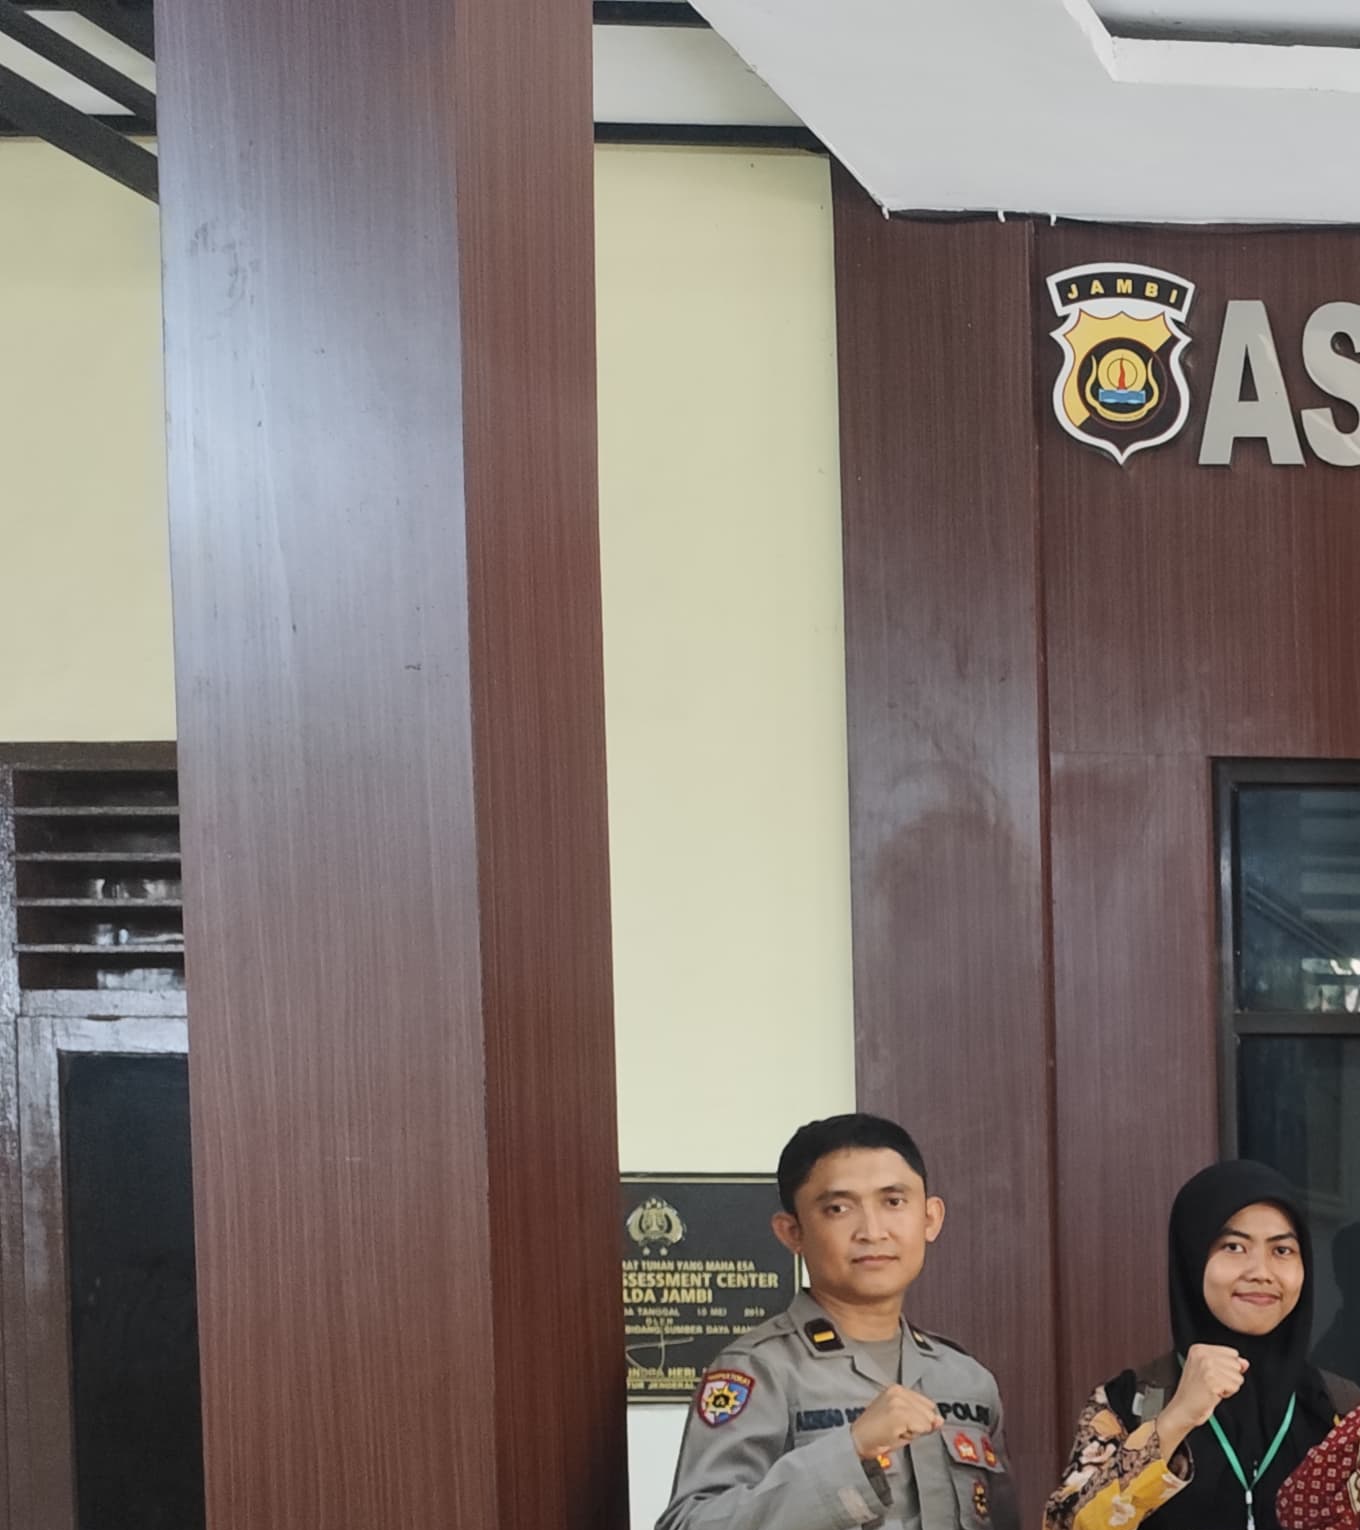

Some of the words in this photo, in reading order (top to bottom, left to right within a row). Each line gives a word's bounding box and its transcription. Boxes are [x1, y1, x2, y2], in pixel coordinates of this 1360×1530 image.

[1067, 278, 1178, 304] JAMBI
[642, 1260, 674, 1271] TUHAN
[676, 1260, 703, 1271] YANG
[705, 1260, 735, 1271] MAHA
[737, 1260, 755, 1271] ESA
[716, 1272, 778, 1289] CENTER
[623, 1288, 656, 1303] LDA
[660, 1288, 713, 1303] JAMBI
[637, 1307, 680, 1317] TANGGAL
[664, 1325, 703, 1334] SUMBER
[705, 1325, 729, 1334] DAYA
